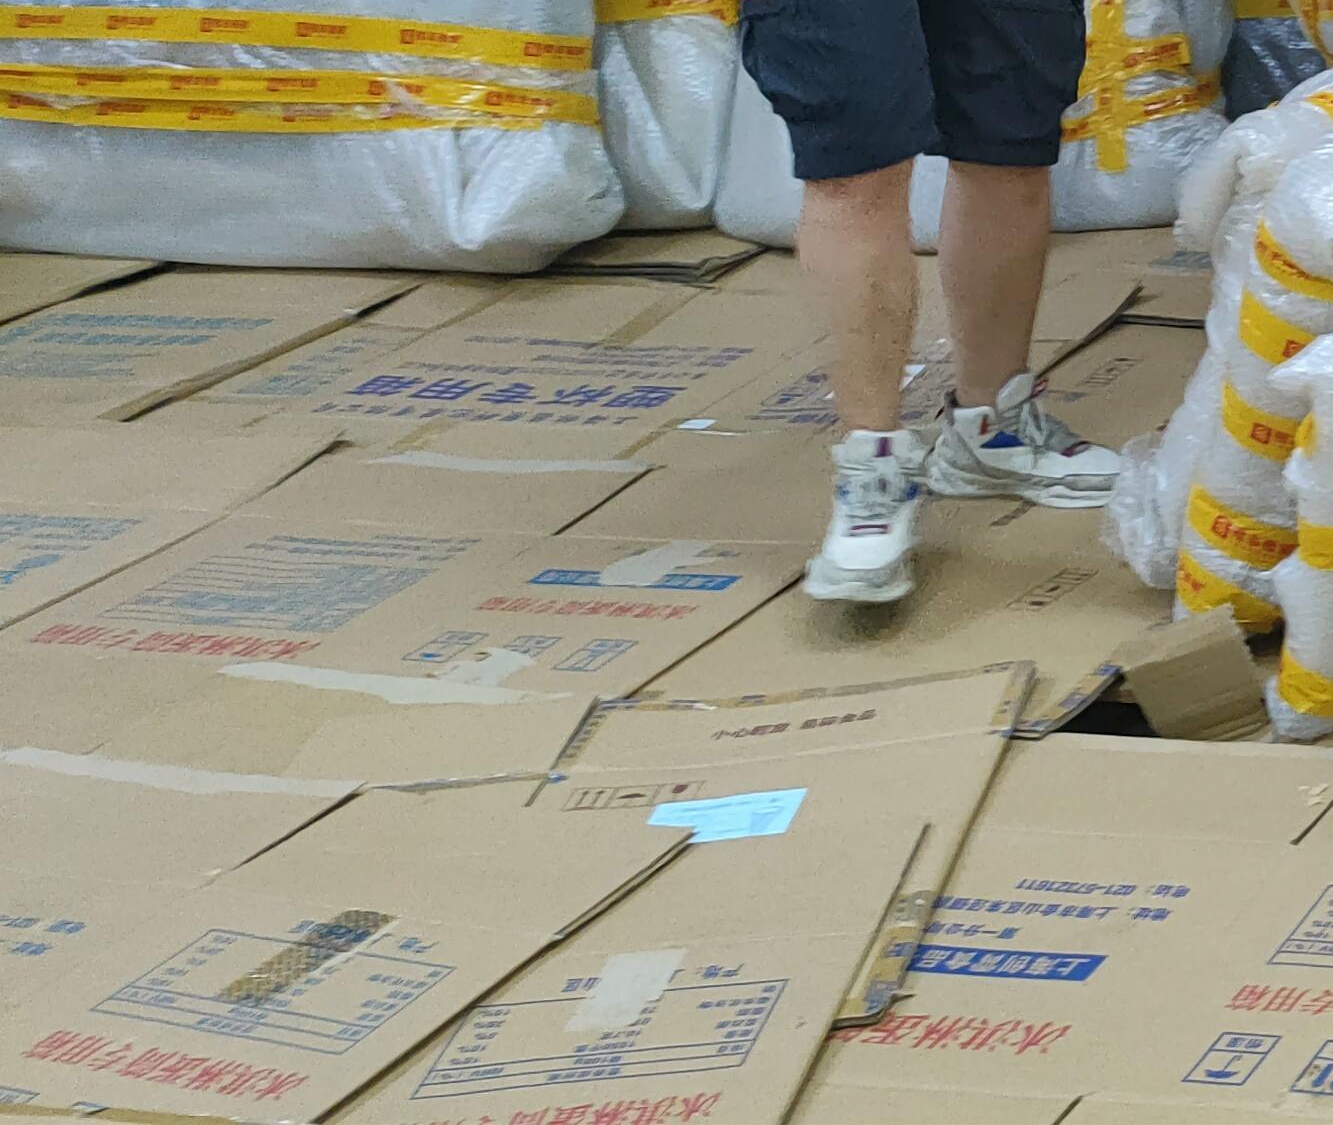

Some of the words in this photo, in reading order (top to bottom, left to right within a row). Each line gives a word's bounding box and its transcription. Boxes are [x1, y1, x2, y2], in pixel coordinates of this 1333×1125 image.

[343, 375, 689, 410] 塑杯专用箱
